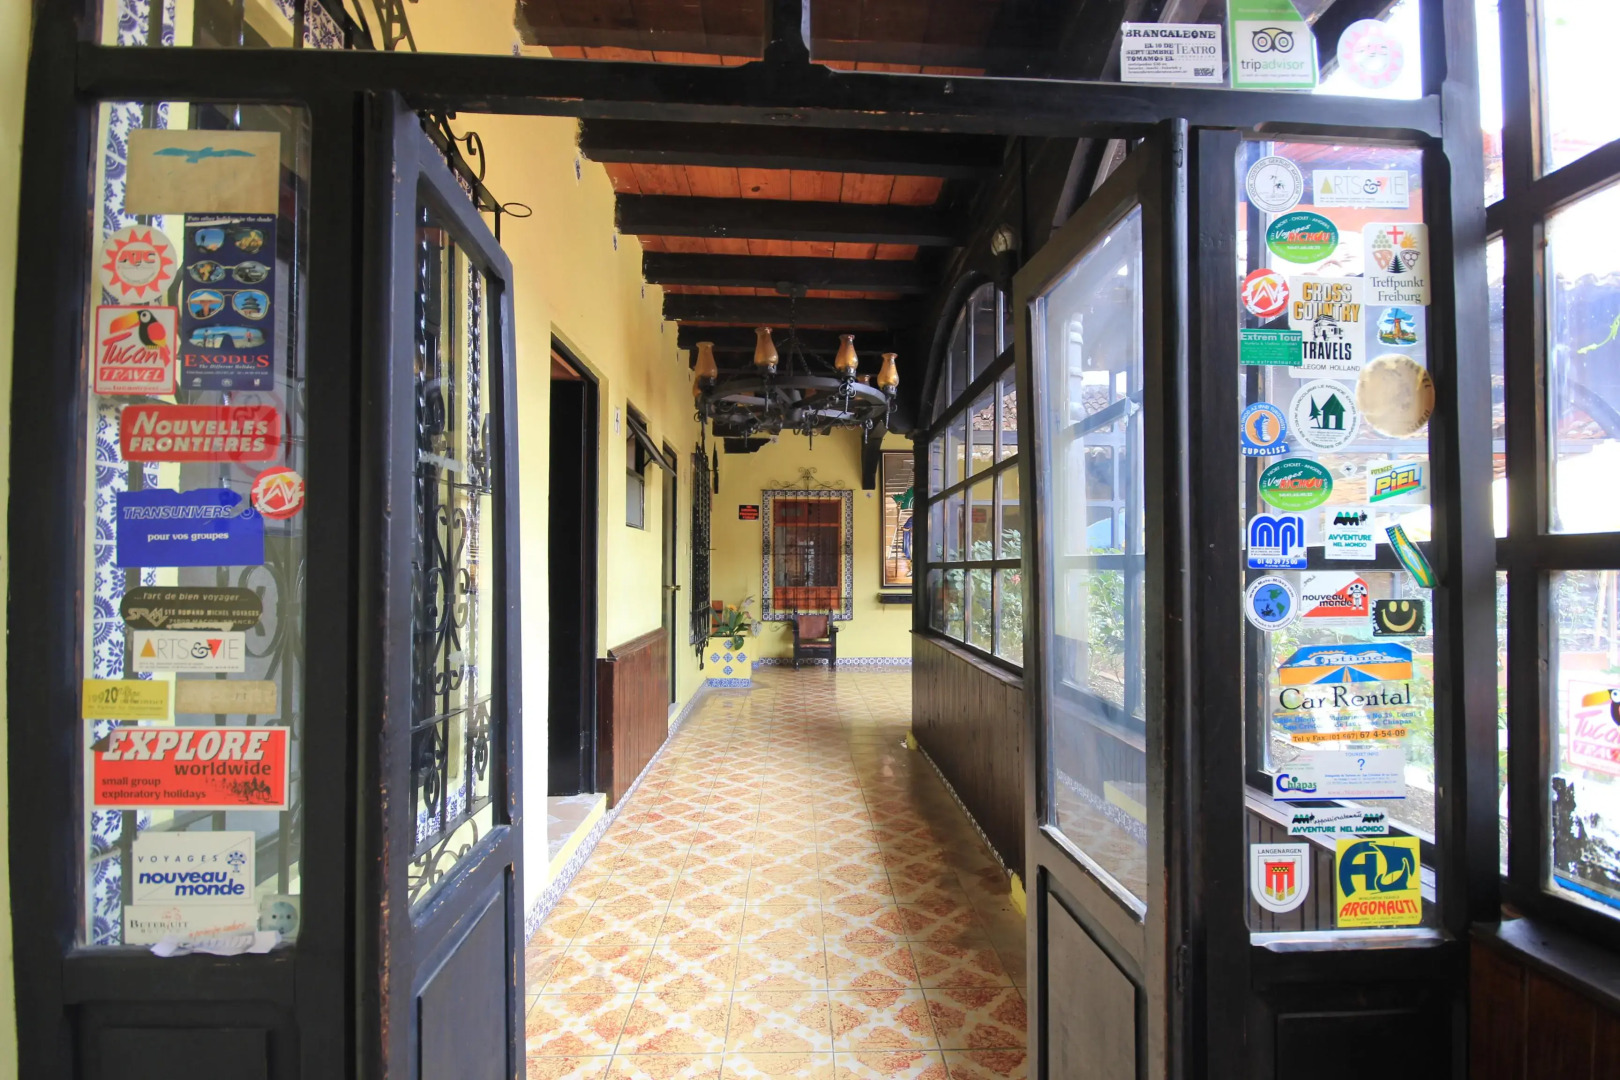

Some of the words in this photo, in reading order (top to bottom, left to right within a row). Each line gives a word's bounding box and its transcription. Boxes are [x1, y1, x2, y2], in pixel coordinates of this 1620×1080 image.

[1126, 29, 1216, 39] BRANCALEONE
[1241, 59, 1305, 72] tripadvisor
[1369, 276, 1425, 289] Treffpunkt
[1302, 282, 1352, 303] CROSS
[1378, 289, 1421, 304] Freiburg
[1293, 301, 1361, 323] COUNTRY
[1240, 332, 1277, 341] Extrem
[1278, 333, 1302, 341] Tour
[102, 332, 159, 365] Tucan
[1302, 341, 1352, 361] TRAVELS
[184, 354, 270, 368] EXODUS
[102, 369, 162, 381] TRAVEL
[132, 411, 268, 435] NOUVELLES
[129, 437, 265, 452] FRONTIERES
[1241, 445, 1286, 455] EUPOLISZ
[123, 505, 232, 519] TRANSUNIVERS
[147, 533, 169, 542] pour
[191, 532, 229, 542] groupes
[1328, 533, 1372, 541] AVVENTURE
[165, 592, 176, 600] de
[178, 592, 200, 600] bien
[1319, 598, 1353, 607] monde
[1279, 688, 1326, 711] Car
[1332, 683, 1411, 708] Rental
[1574, 710, 1620, 745] Tuca
[1359, 731, 1370, 739] 67
[102, 731, 270, 761] EXPLORE
[174, 761, 272, 776] worldwide
[102, 777, 129, 786] small
[131, 778, 161, 787] group
[1276, 774, 1317, 794] Chiapas
[102, 790, 161, 800] exploratory
[163, 789, 206, 799] holidays
[138, 855, 218, 863] VOYAGES
[139, 871, 227, 884] nouveau
[174, 878, 245, 896] monde
[1339, 899, 1418, 918] ARGONAUTI
